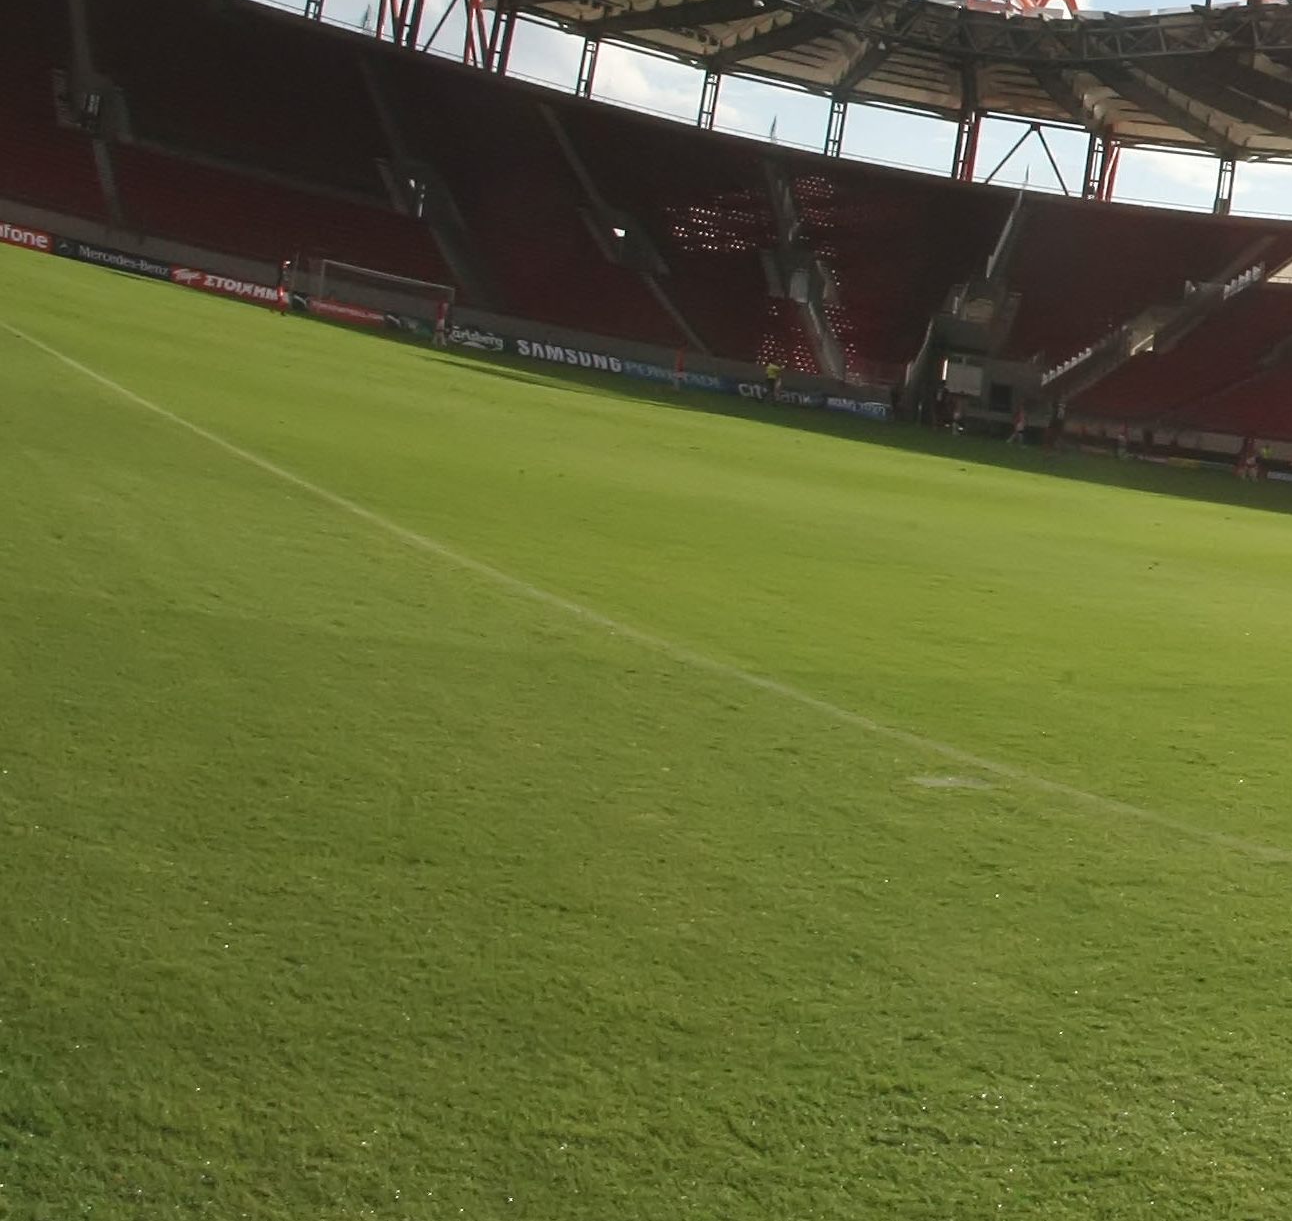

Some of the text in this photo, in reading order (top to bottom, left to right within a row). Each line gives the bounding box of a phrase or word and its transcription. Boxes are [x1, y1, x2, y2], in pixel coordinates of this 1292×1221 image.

[0, 223, 49, 249] fone
[78, 244, 169, 276] Mercedes-Benz
[516, 338, 622, 373] SAMSUNG
